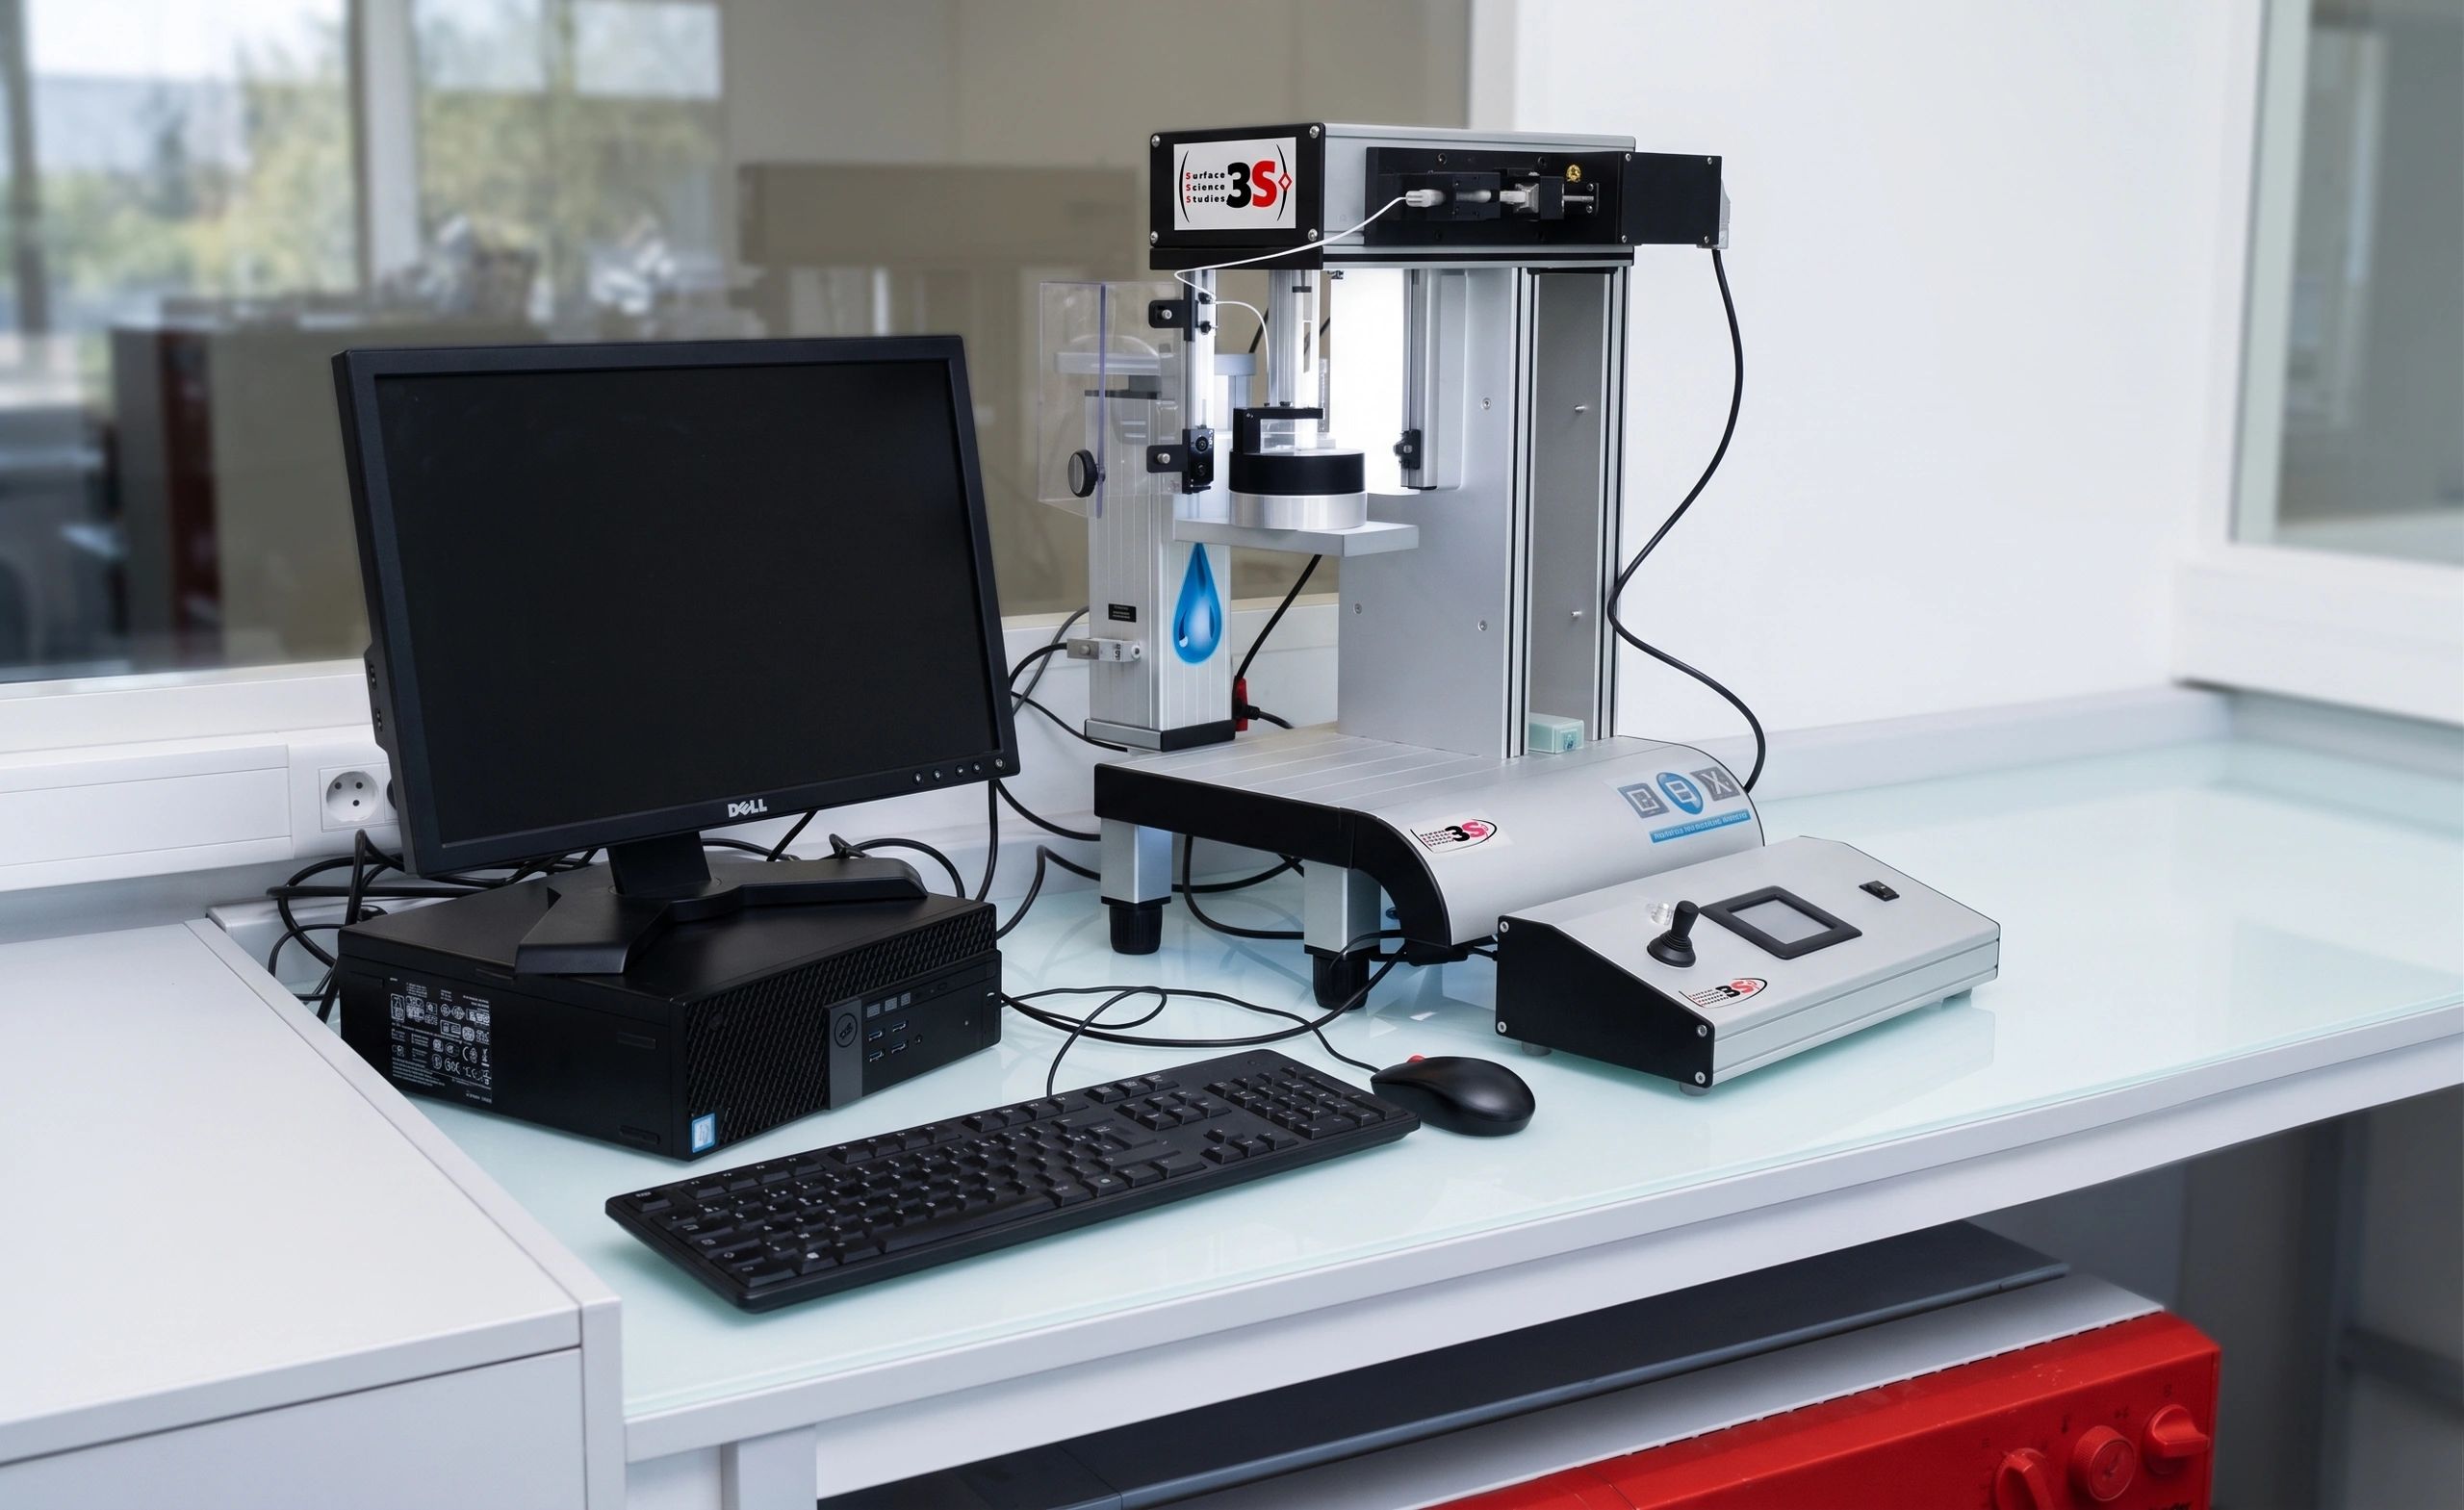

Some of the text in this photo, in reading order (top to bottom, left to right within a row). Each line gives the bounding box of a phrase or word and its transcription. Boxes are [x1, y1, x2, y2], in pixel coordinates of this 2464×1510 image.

[1185, 171, 1225, 180] Surface
[1226, 160, 1278, 209] 3S
[727, 798, 768, 818] DELL
[1444, 821, 1486, 842] 3S
